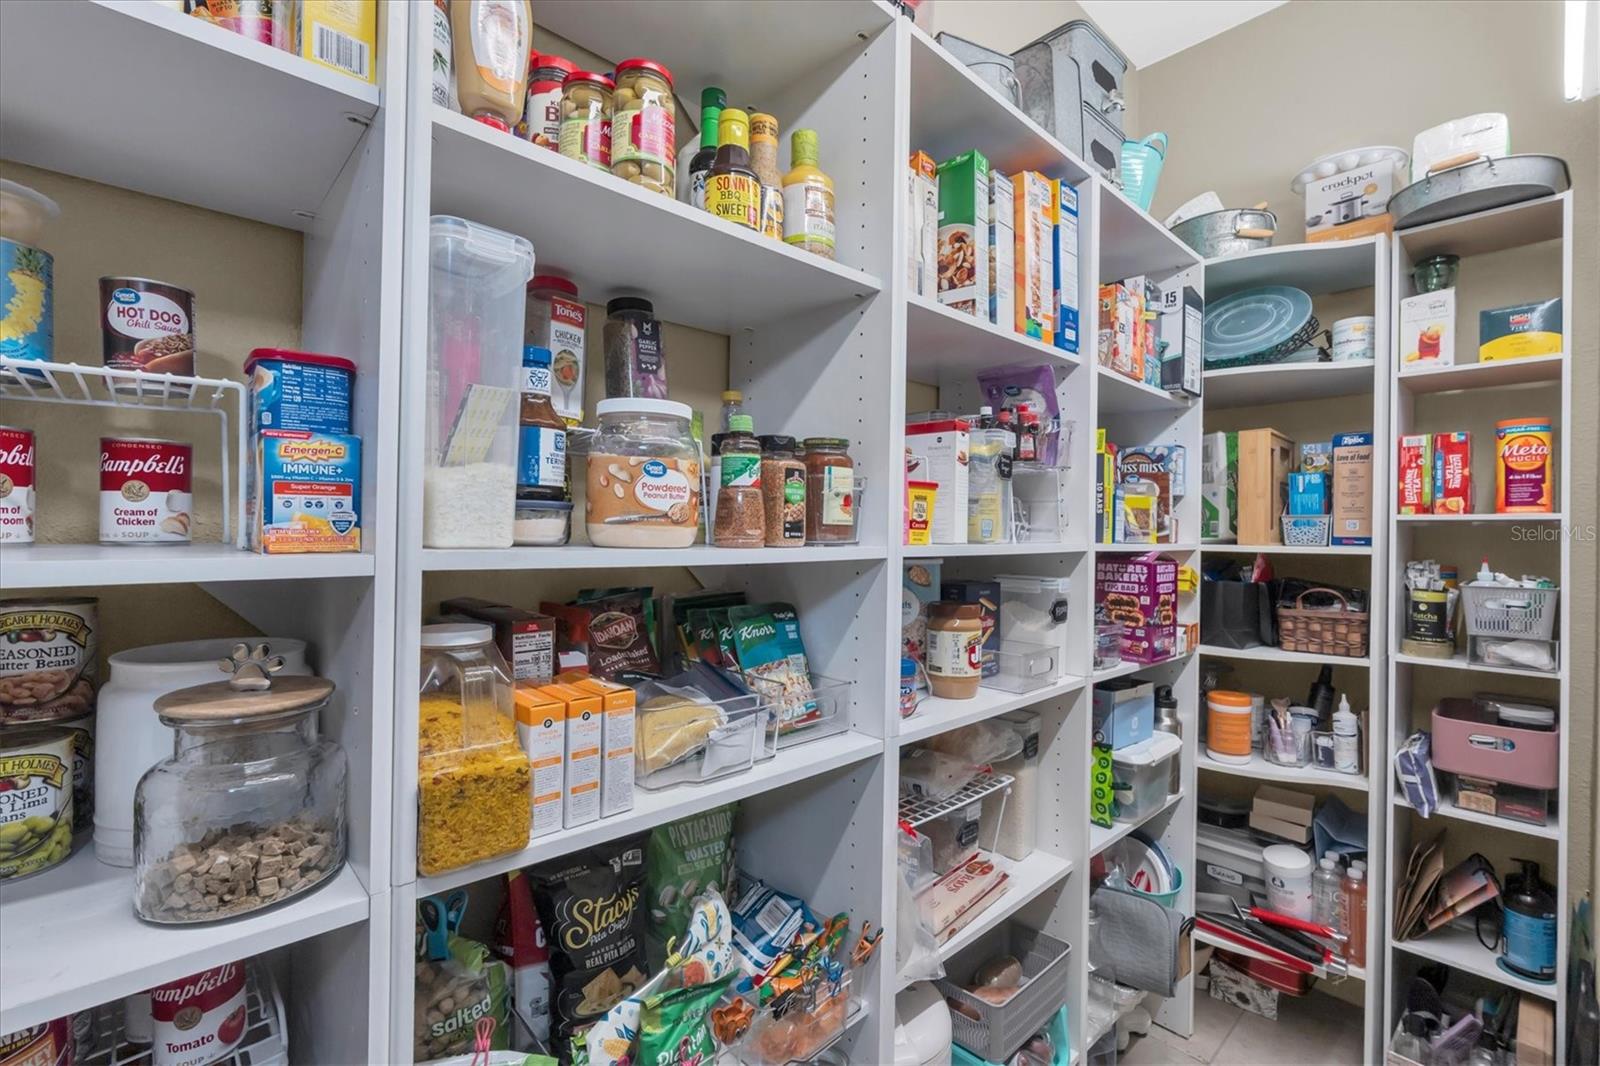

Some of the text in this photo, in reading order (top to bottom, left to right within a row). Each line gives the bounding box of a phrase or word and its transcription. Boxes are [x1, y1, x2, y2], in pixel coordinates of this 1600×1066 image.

[1321, 170, 1374, 193] crockpot
[720, 190, 741, 202] BBQ
[716, 203, 747, 217] SWEET
[1164, 291, 1177, 304] 15
[117, 306, 181, 325] HOT DOG
[554, 303, 583, 322] Tone's
[126, 319, 182, 333] Chili Sauce
[555, 329, 582, 345] CHICKEN
[1341, 435, 1365, 446] Ziploc
[283, 445, 343, 456] Emergen-C
[1500, 444, 1550, 457] Meta
[99, 454, 184, 476] Campbell's
[282, 463, 344, 476] IMMUNE+
[290, 483, 337, 492] Super Orange
[641, 482, 687, 493] Powdered
[11, 505, 21, 515] of
[113, 505, 158, 518] Cream of
[116, 517, 156, 527] Chicken
[1096, 572, 1148, 583] BAKERY
[39, 614, 80, 630] HOLMES
[738, 624, 776, 641] Knorr
[0, 645, 77, 660] EASONED
[35, 657, 76, 669] Beans
[11, 759, 58, 771] HOLMES
[10, 796, 48, 812] Lima
[668, 810, 732, 849] PISTACHIOS
[565, 887, 640, 950] Stacy's
[585, 955, 602, 969] REAL
[603, 949, 619, 963] PITA
[431, 994, 492, 1038] salted
[166, 1032, 215, 1054] Tomato
